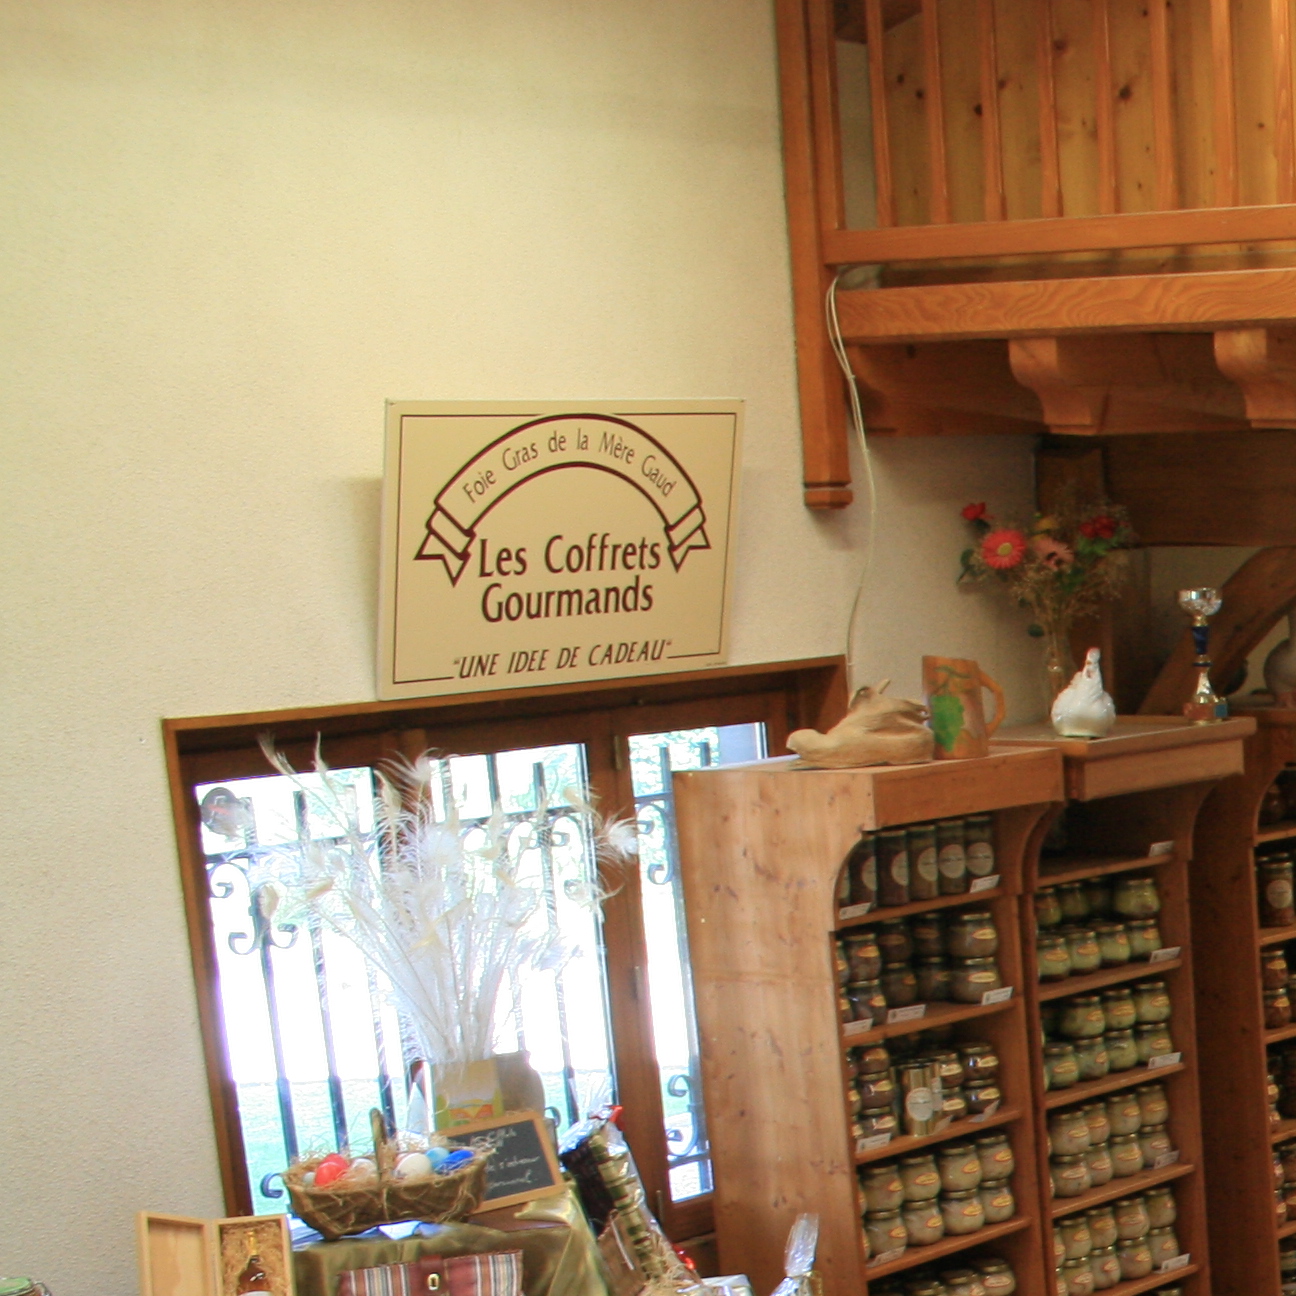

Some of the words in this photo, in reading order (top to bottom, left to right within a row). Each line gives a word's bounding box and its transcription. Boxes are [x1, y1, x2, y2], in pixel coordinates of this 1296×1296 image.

[462, 468, 497, 503] Foie
[502, 440, 539, 471] Gras
[548, 430, 567, 453] de
[576, 428, 589, 450] la
[600, 431, 635, 463] Mère
[641, 454, 677, 497] Gaud
[479, 538, 527, 578] Les
[544, 533, 661, 574] Coffrets
[481, 575, 654, 623] Gourmands
[507, 649, 550, 673] IDEE
[556, 646, 580, 669] DE
